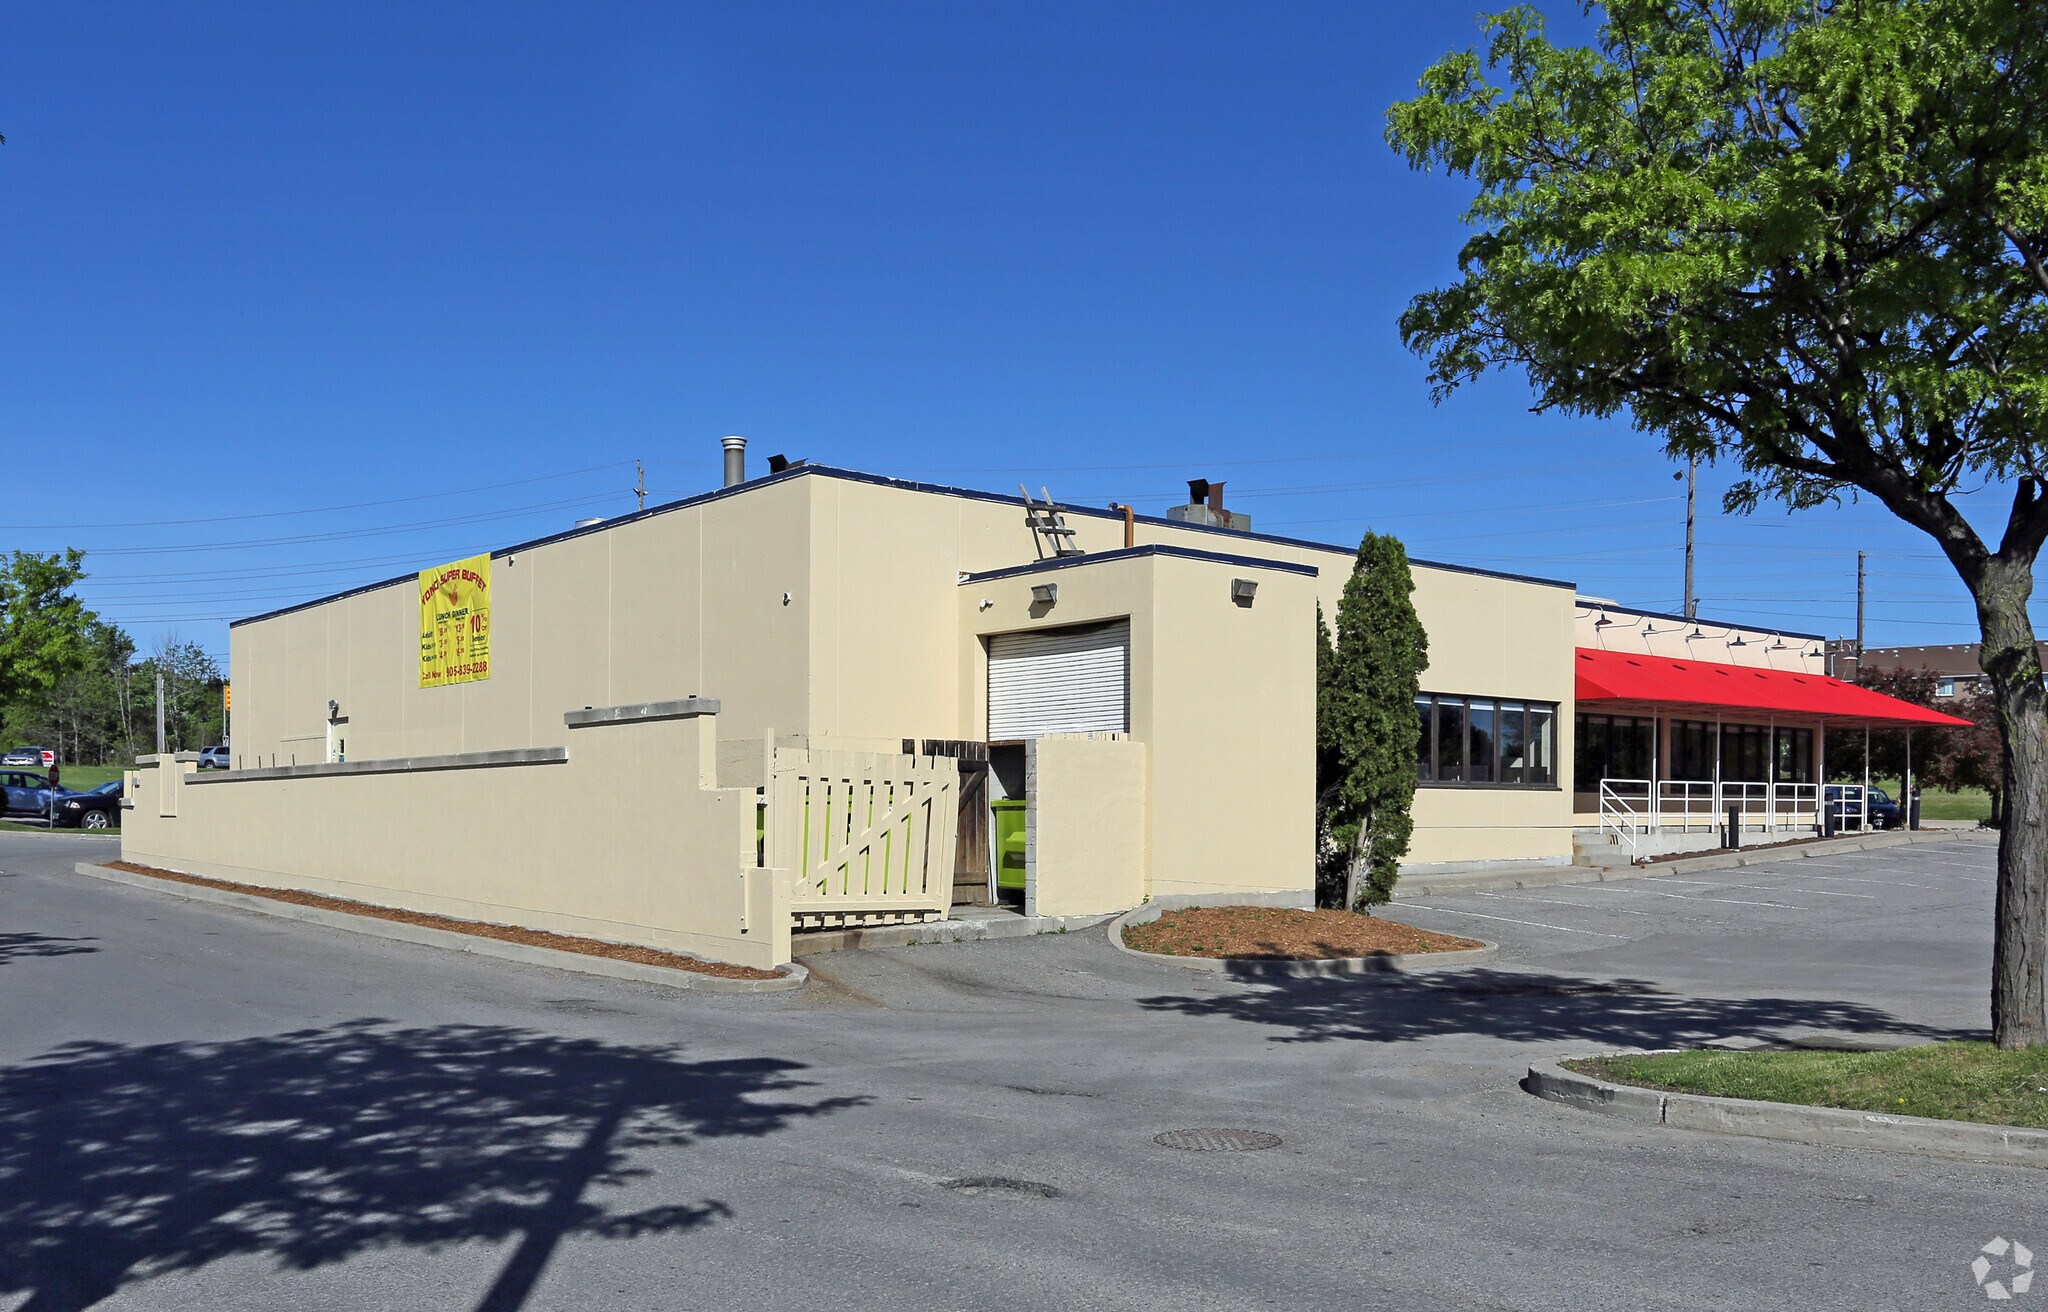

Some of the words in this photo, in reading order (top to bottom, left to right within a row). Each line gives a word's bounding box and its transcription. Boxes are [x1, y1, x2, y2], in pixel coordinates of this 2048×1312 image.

[441, 569, 460, 585] SUPER
[462, 569, 486, 592] BUFFET
[452, 608, 468, 618] DINNER
[446, 661, 487, 677] 905-839-2288
